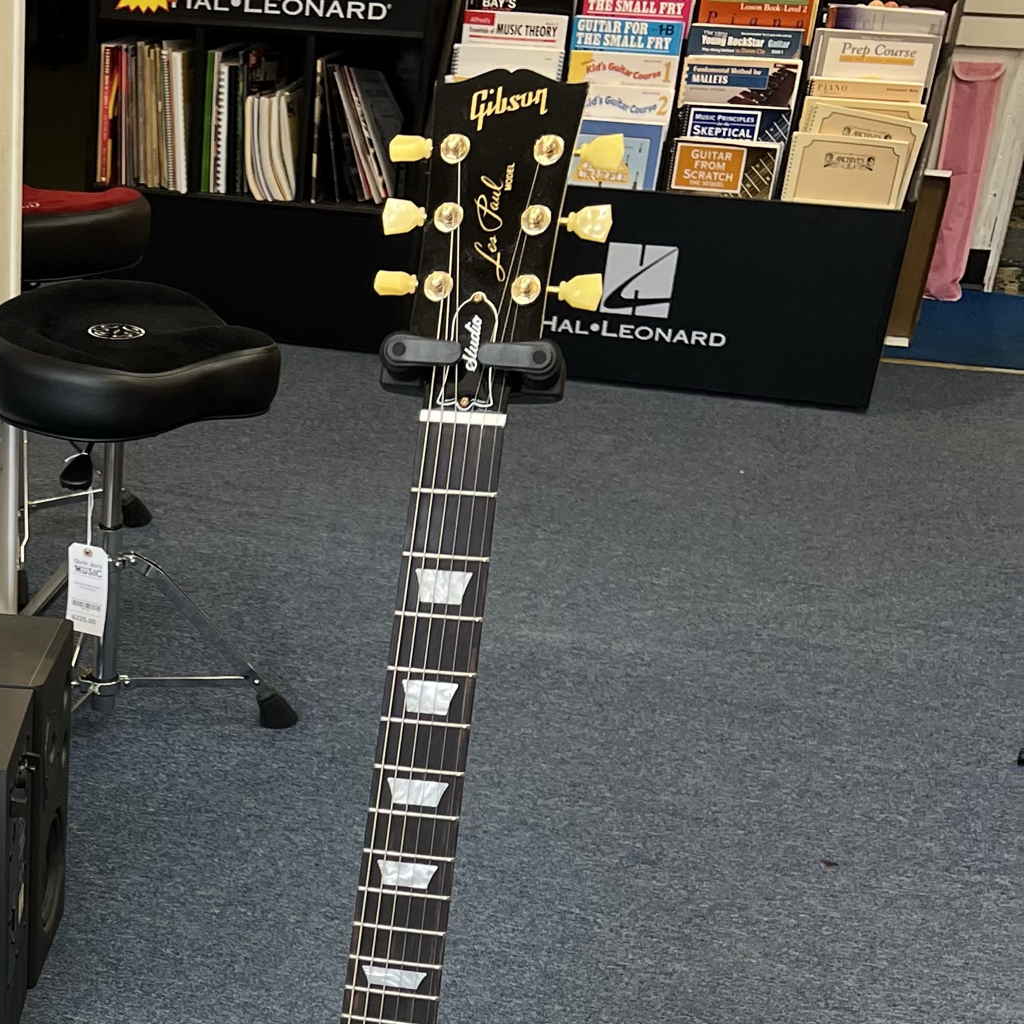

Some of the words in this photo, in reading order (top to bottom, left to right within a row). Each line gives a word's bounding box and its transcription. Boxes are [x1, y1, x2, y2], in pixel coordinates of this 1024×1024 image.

[589, 0, 613, 11] THE
[615, 0, 657, 13] SMALL
[659, 2, 685, 15] FRY
[496, 24, 524, 35] MUSIC
[525, 25, 558, 37] THEORY
[577, 19, 622, 34] GUITAR
[624, 21, 649, 35] FOR
[576, 32, 601, 46] THE
[603, 34, 644, 48] SMALL
[647, 37, 673, 50] FRY
[702, 34, 727, 47] Young
[841, 42, 870, 58] Prep
[875, 43, 918, 58] Course
[586, 62, 606, 73] Kid's
[633, 71, 661, 80] Course
[692, 74, 728, 85] MALLETS
[469, 86, 549, 131] Gibson
[657, 96, 668, 115] 2
[693, 125, 753, 139] SKEPTICAL
[690, 149, 733, 161] GUITAR
[694, 160, 726, 170] FROM
[682, 169, 734, 182] SCRATCH
[475, 175, 505, 232] Paul
